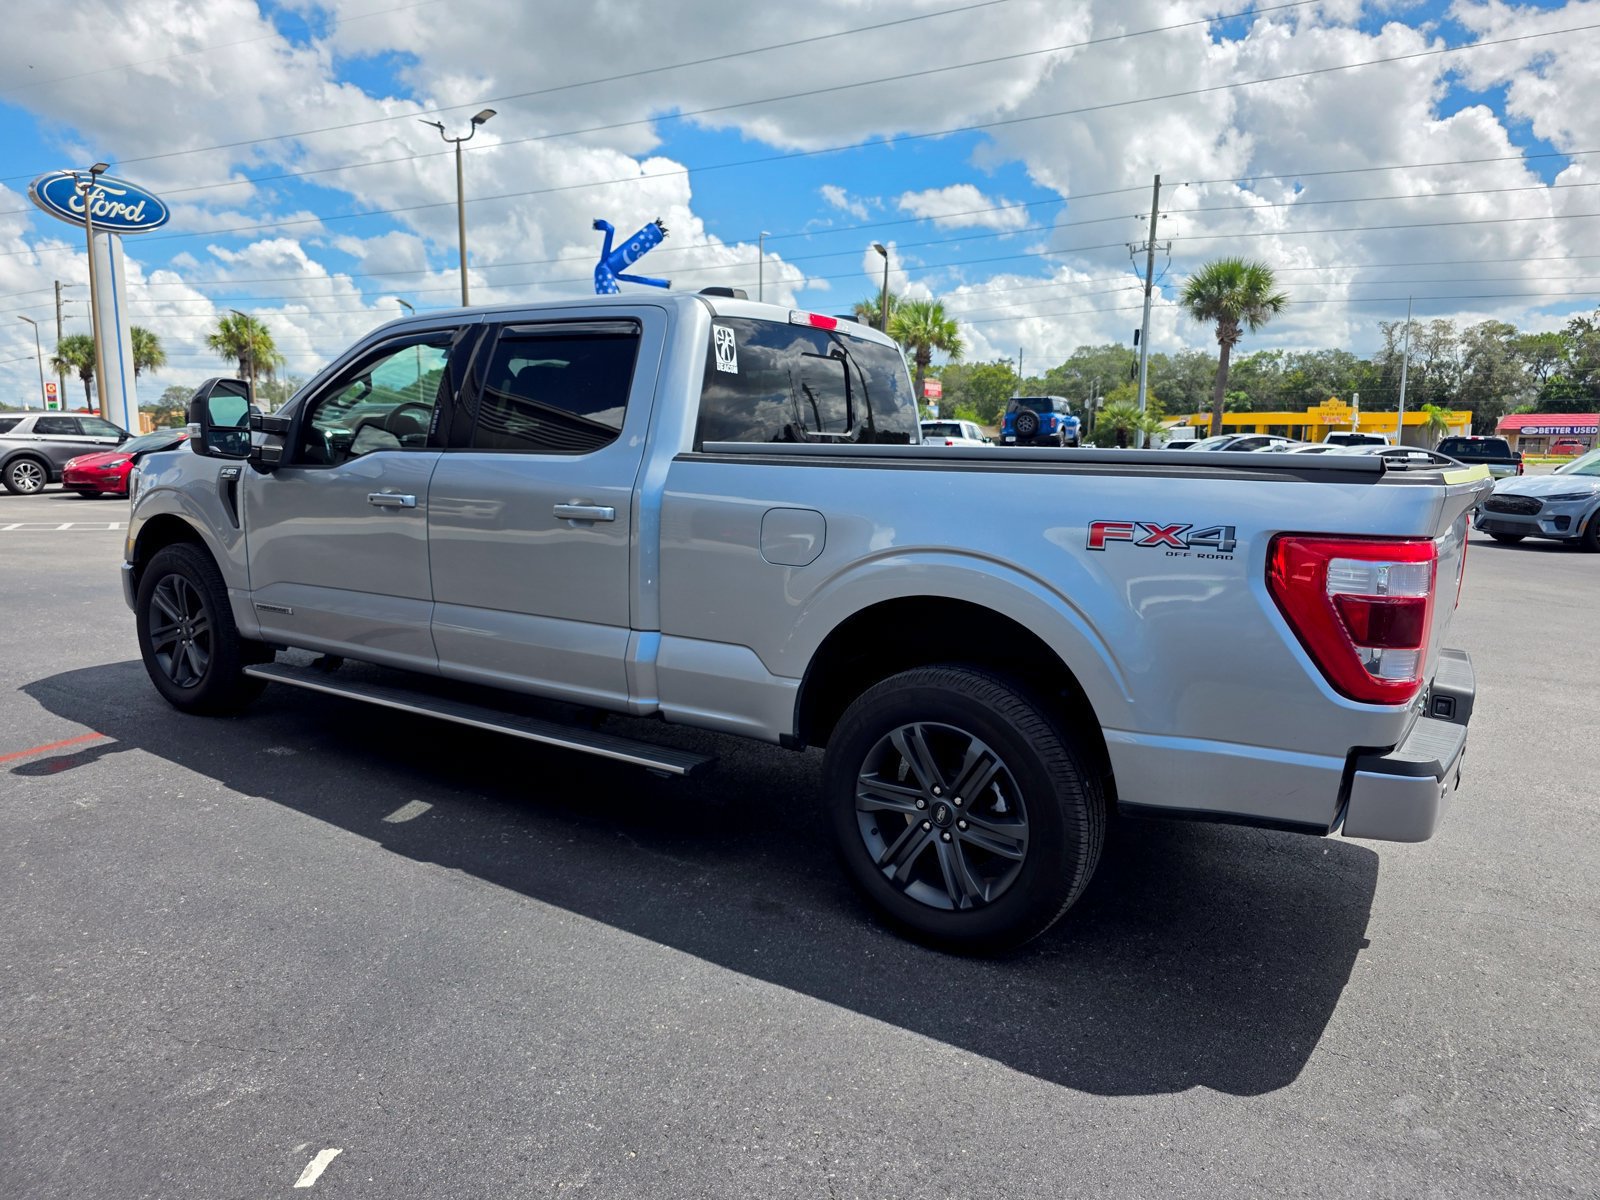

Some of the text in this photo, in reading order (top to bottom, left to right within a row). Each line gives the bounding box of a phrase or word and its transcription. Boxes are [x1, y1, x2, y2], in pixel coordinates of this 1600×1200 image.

[68, 182, 146, 222] Ford
[716, 361, 738, 374] DEACON
[1538, 426, 1571, 434] BETTER
[1573, 426, 1598, 434] USED
[1086, 519, 1236, 553] FX4
[1197, 553, 1234, 561] ROAD
